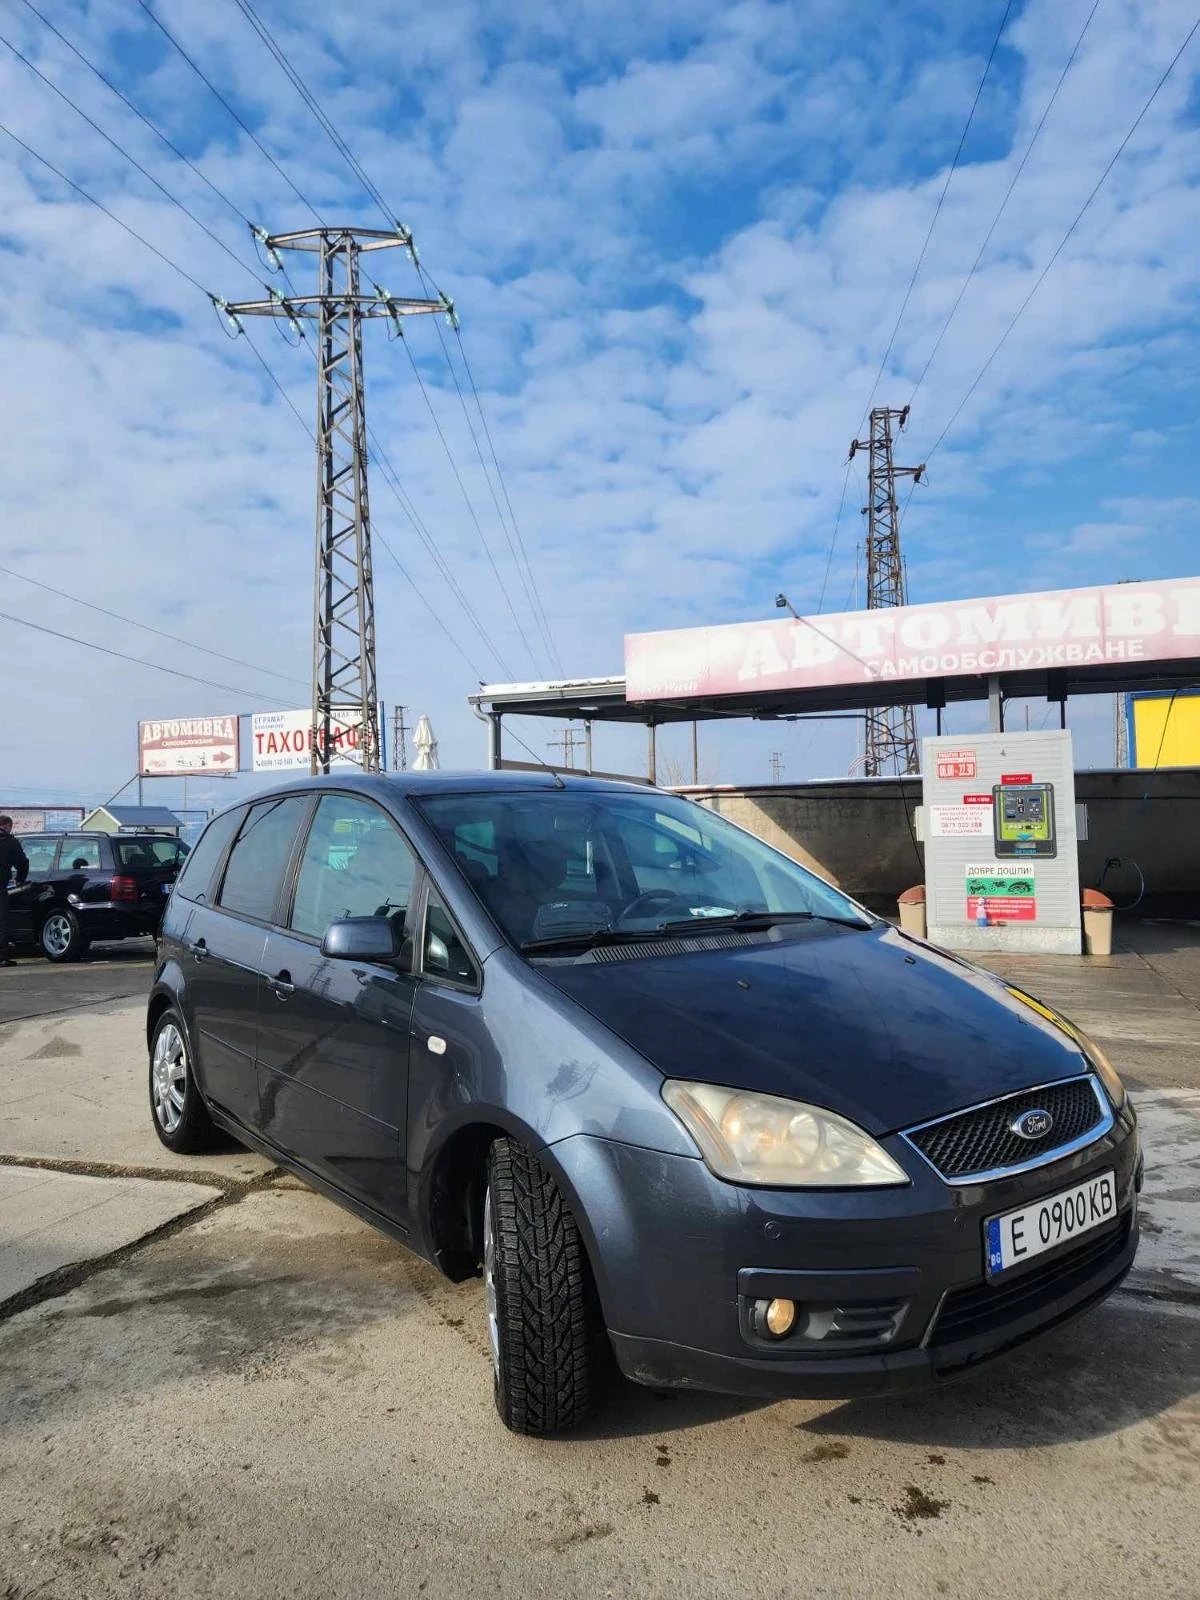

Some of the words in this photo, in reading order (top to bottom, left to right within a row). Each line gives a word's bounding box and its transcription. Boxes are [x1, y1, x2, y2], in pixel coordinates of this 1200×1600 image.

[863, 639, 1144, 679] САМООБСЛУЖВАНЕ
[142, 719, 235, 745] АВТОМИВКА
[255, 725, 375, 755] ТАХОГРАФ
[968, 867, 994, 875] ДОБРЕ
[997, 867, 1032, 875] ДОШЛИ!
[1028, 1115, 1047, 1133] Ford
[1011, 1216, 1027, 1257] E
[991, 1251, 1001, 1266] BG
